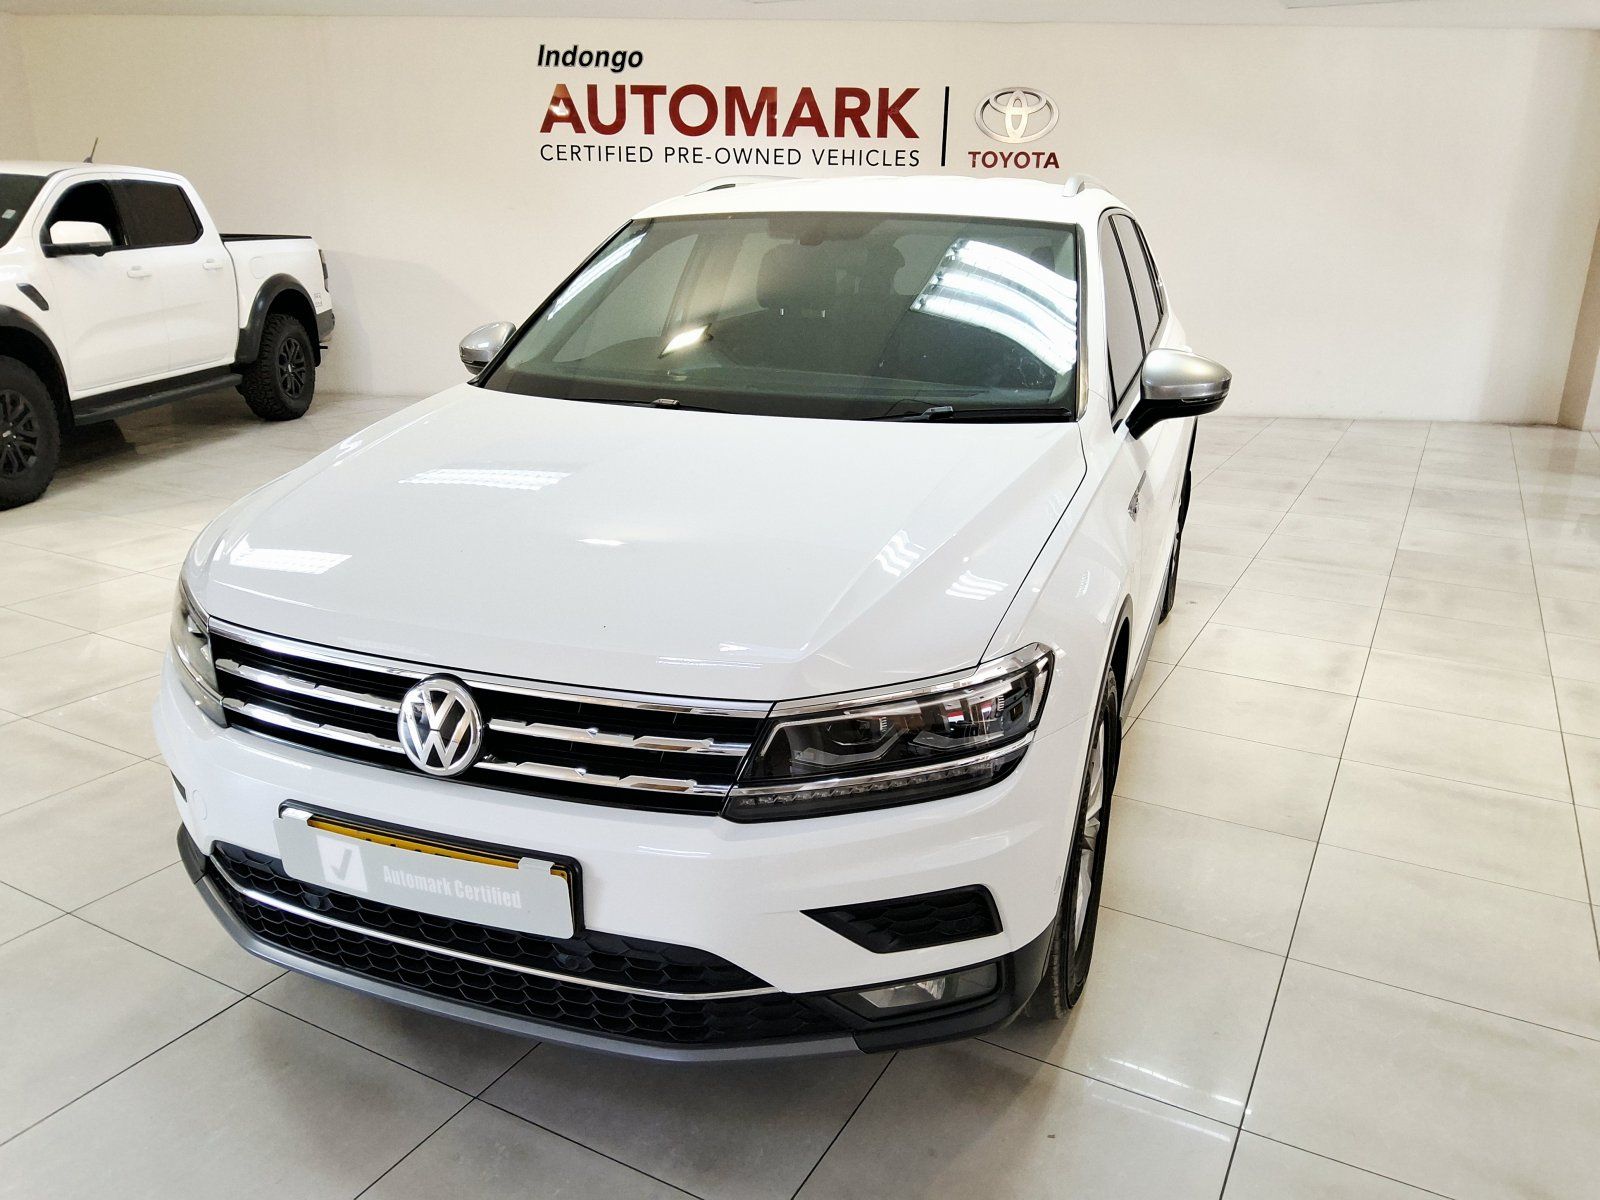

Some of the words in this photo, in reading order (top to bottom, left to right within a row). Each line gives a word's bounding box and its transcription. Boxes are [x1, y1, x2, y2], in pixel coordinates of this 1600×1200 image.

[537, 44, 644, 73] Indongo
[540, 83, 921, 139] AUTOMARK
[540, 144, 653, 163] CERTIFIED
[664, 146, 802, 166] PRE-OWNED
[812, 148, 920, 167] VEHICLES
[968, 151, 1060, 170] TOYOTA
[400, 680, 477, 773] VW
[383, 865, 452, 896] Automark
[454, 880, 522, 909] Certified
